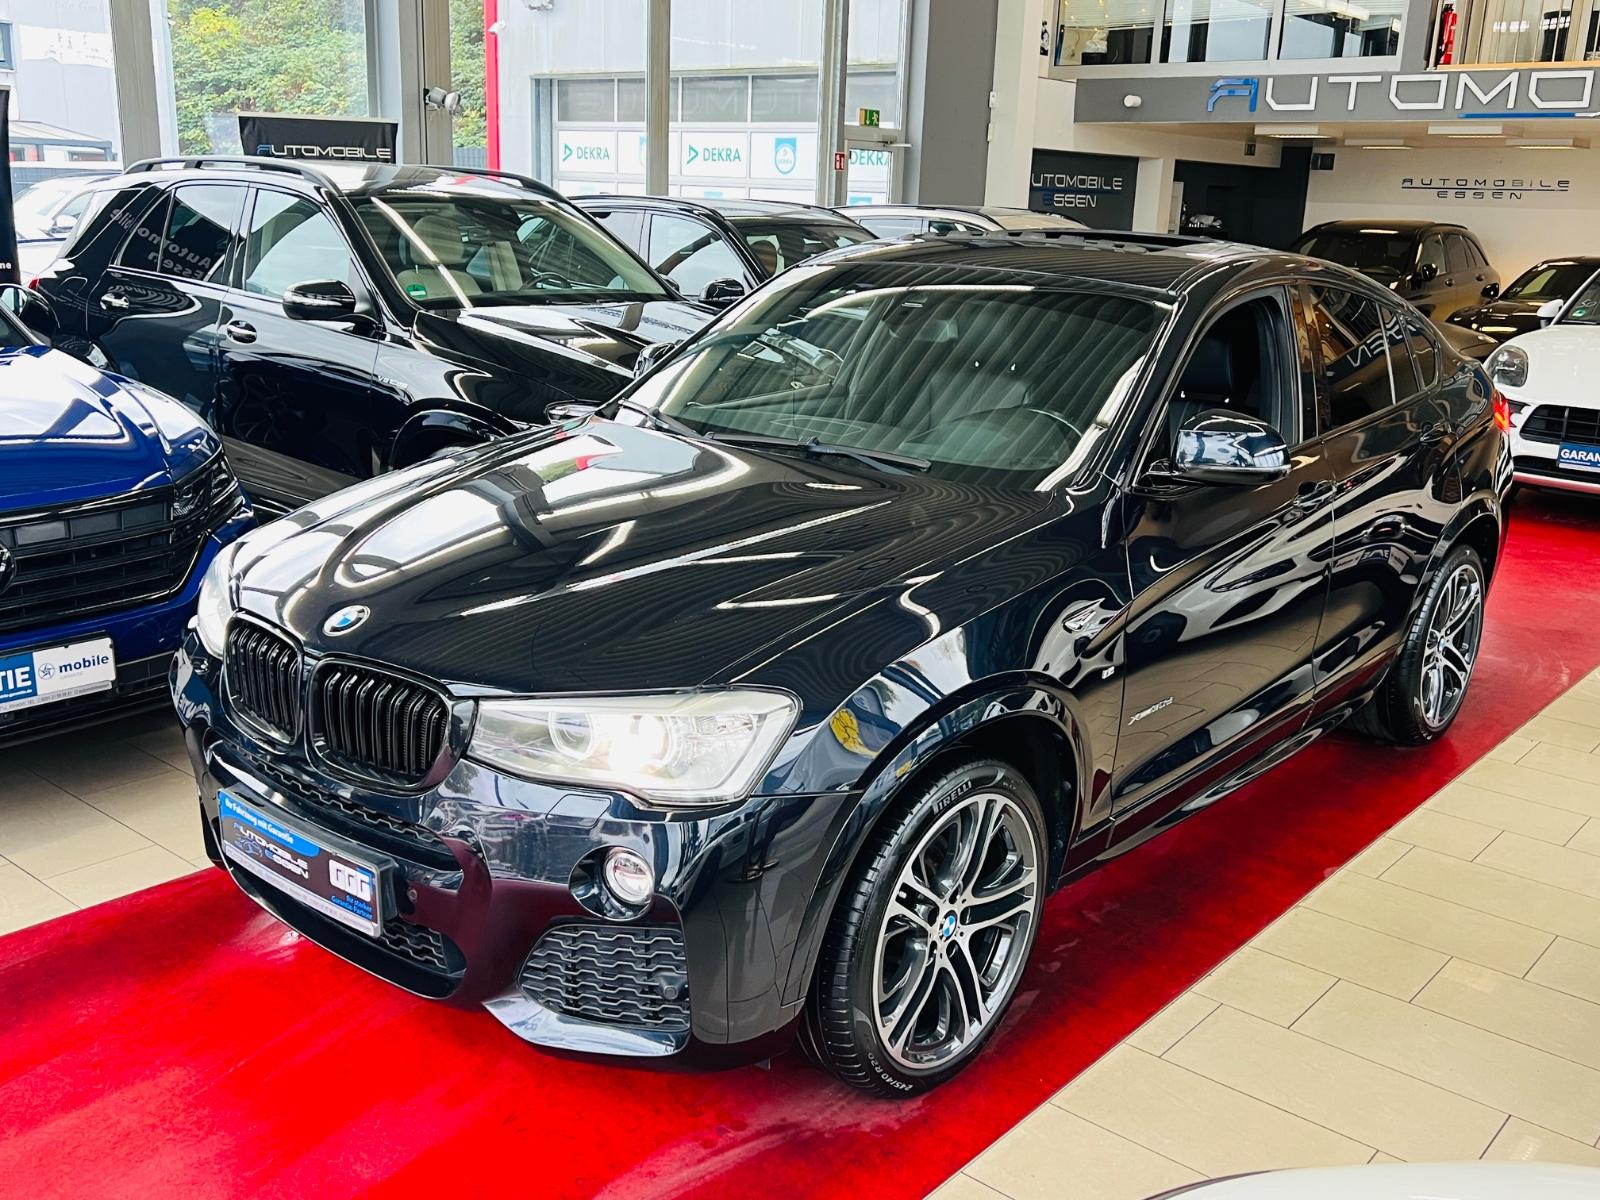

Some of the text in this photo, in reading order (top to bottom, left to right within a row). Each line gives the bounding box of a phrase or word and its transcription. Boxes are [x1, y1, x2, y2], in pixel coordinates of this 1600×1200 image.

[1206, 70, 1594, 112] AUTOMO
[256, 144, 391, 159] AUTOMOBILE
[576, 146, 610, 160] DEKRA
[702, 147, 741, 162] DEKRA
[1401, 178, 1570, 188] AUTOMOBILE
[1043, 193, 1097, 208] ESSEN
[1436, 190, 1523, 200] ESSEN
[58, 655, 109, 673] mobile
[931, 780, 972, 815] PIRELLI
